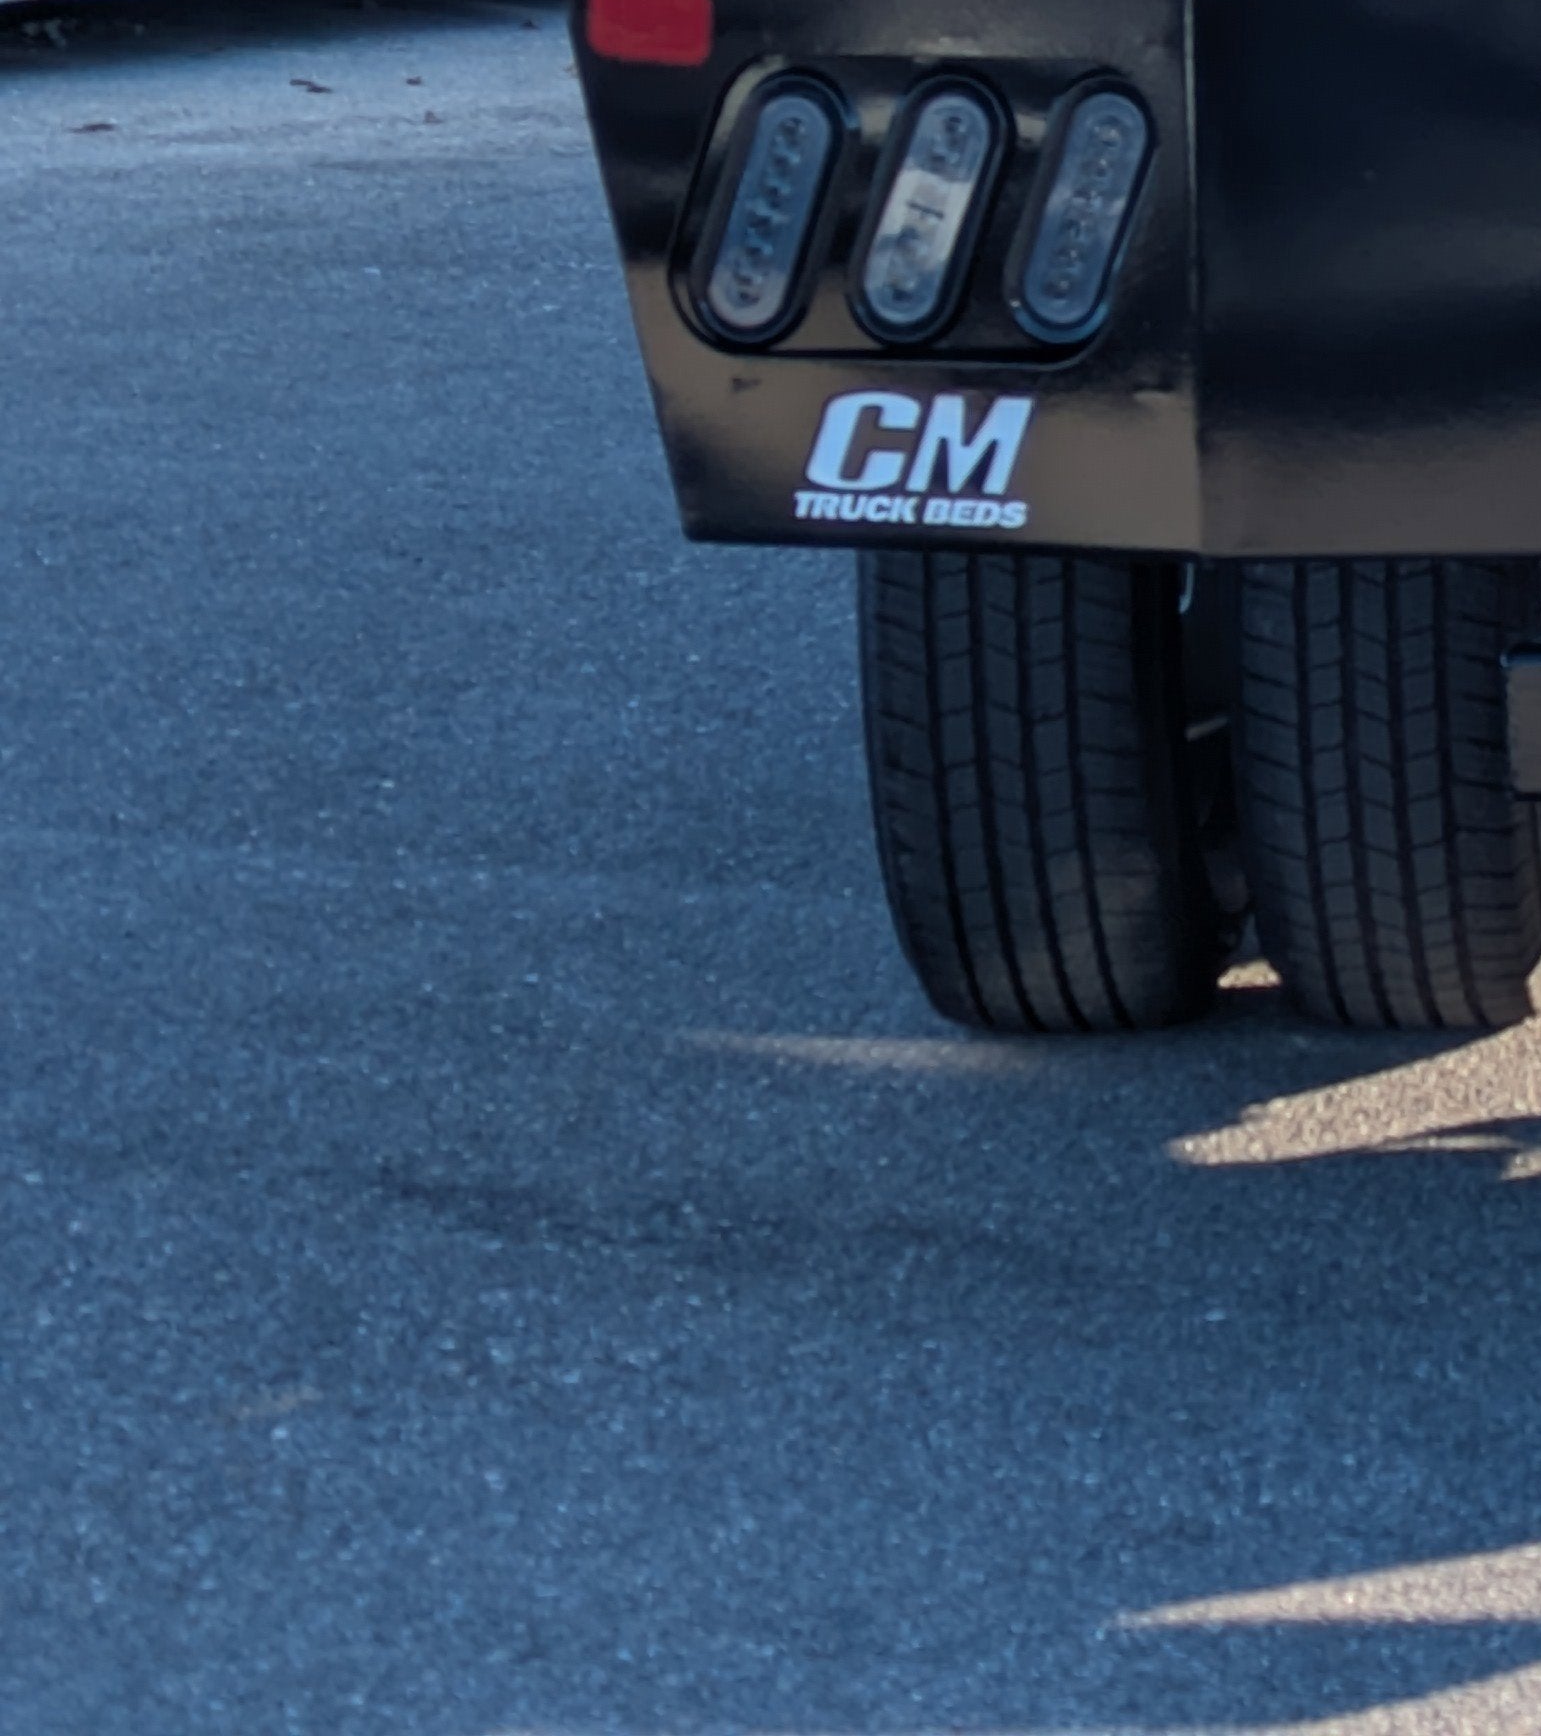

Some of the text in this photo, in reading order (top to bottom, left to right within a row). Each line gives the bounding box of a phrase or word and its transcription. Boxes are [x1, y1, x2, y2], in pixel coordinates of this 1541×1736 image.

[805, 390, 1035, 495] CM
[793, 490, 1029, 529] TRUCK BEDS
